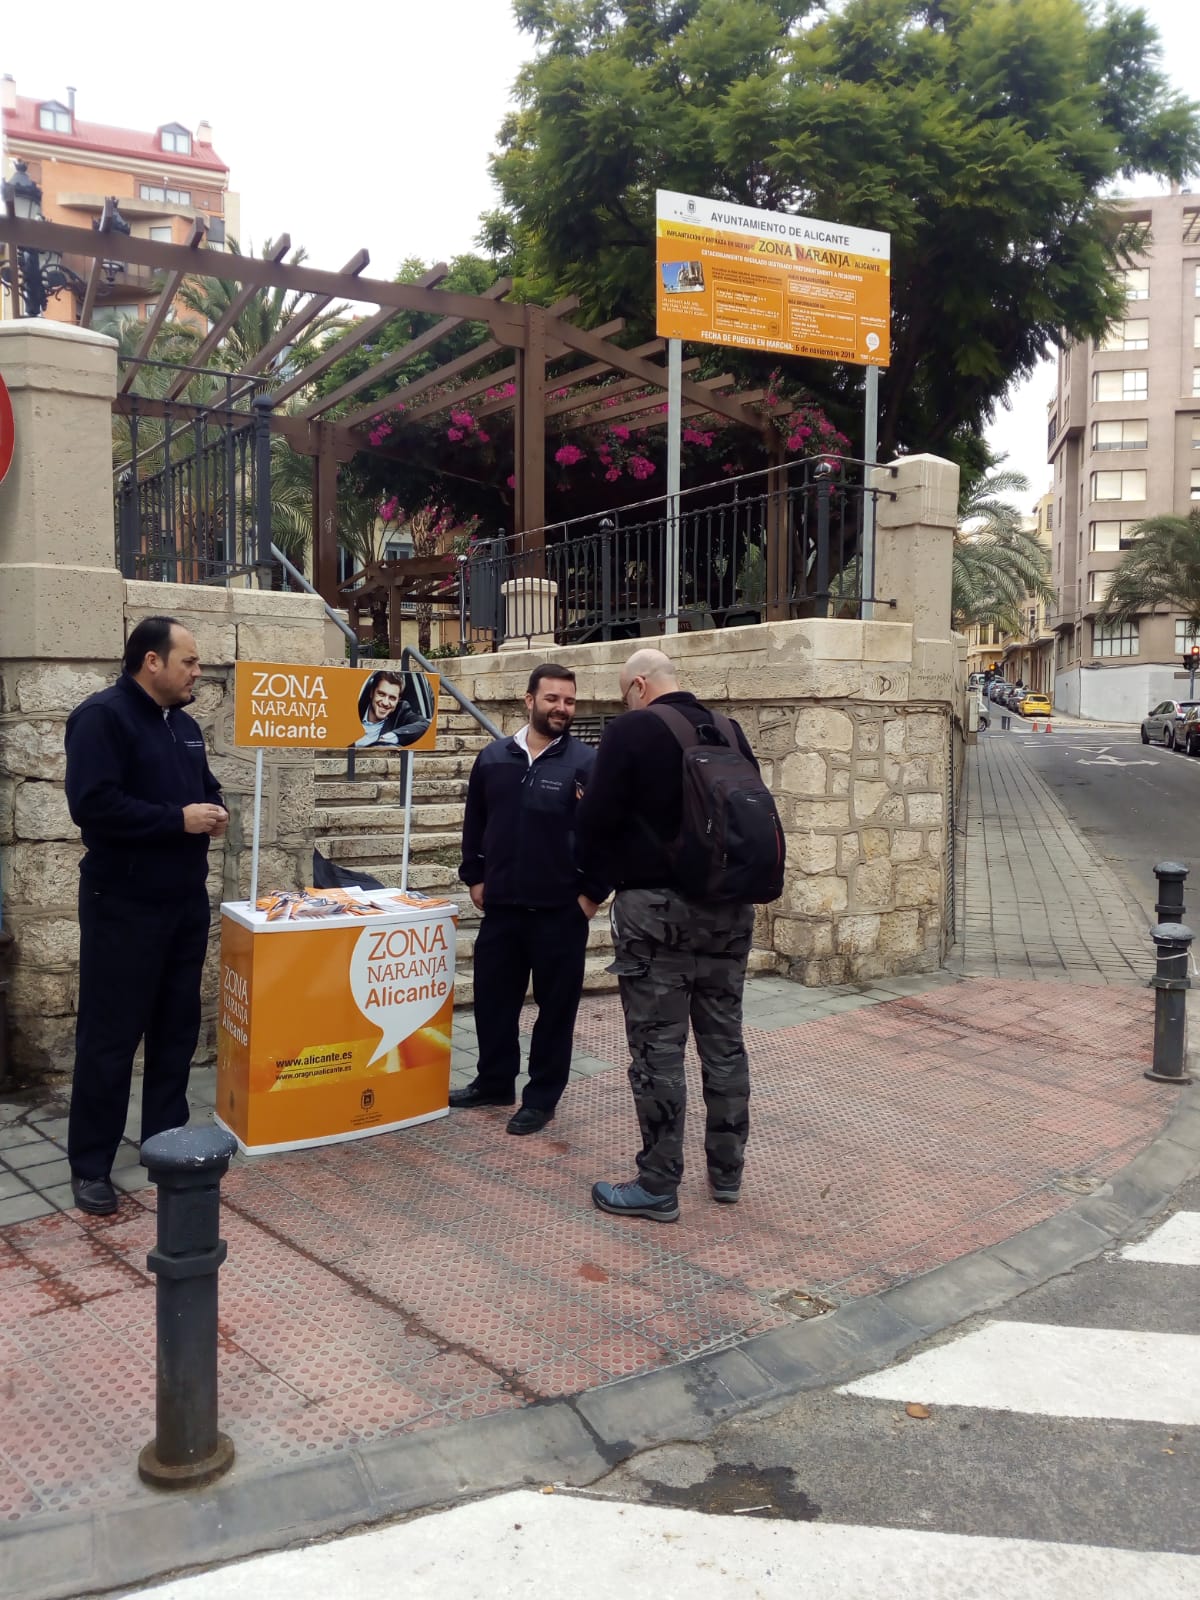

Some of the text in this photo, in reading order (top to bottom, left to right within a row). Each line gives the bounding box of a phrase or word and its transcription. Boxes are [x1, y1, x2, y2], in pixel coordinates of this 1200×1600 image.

[711, 212, 786, 234] AYUNTAMIENTO
[789, 226, 801, 236] DE
[804, 229, 849, 245] ALICANTE
[759, 240, 792, 256] ZONA
[796, 247, 850, 269] NARANJA
[855, 261, 880, 272] ALICANTE
[701, 331, 721, 340] FECHA
[733, 335, 756, 345] PUESTA
[757, 338, 765, 346] EN
[810, 347, 839, 356] noviembre
[252, 672, 328, 699] ZONA
[251, 699, 328, 721] NARANJA
[249, 720, 327, 739] Alicante
[367, 924, 448, 961] ZONA
[367, 955, 448, 983] NARANJA
[224, 965, 249, 1006] ZONA
[365, 979, 447, 1009] Alicante
[223, 992, 249, 1025] NARANJA
[222, 1011, 248, 1047] Alicante
[275, 1051, 353, 1069] www.alicante.es
